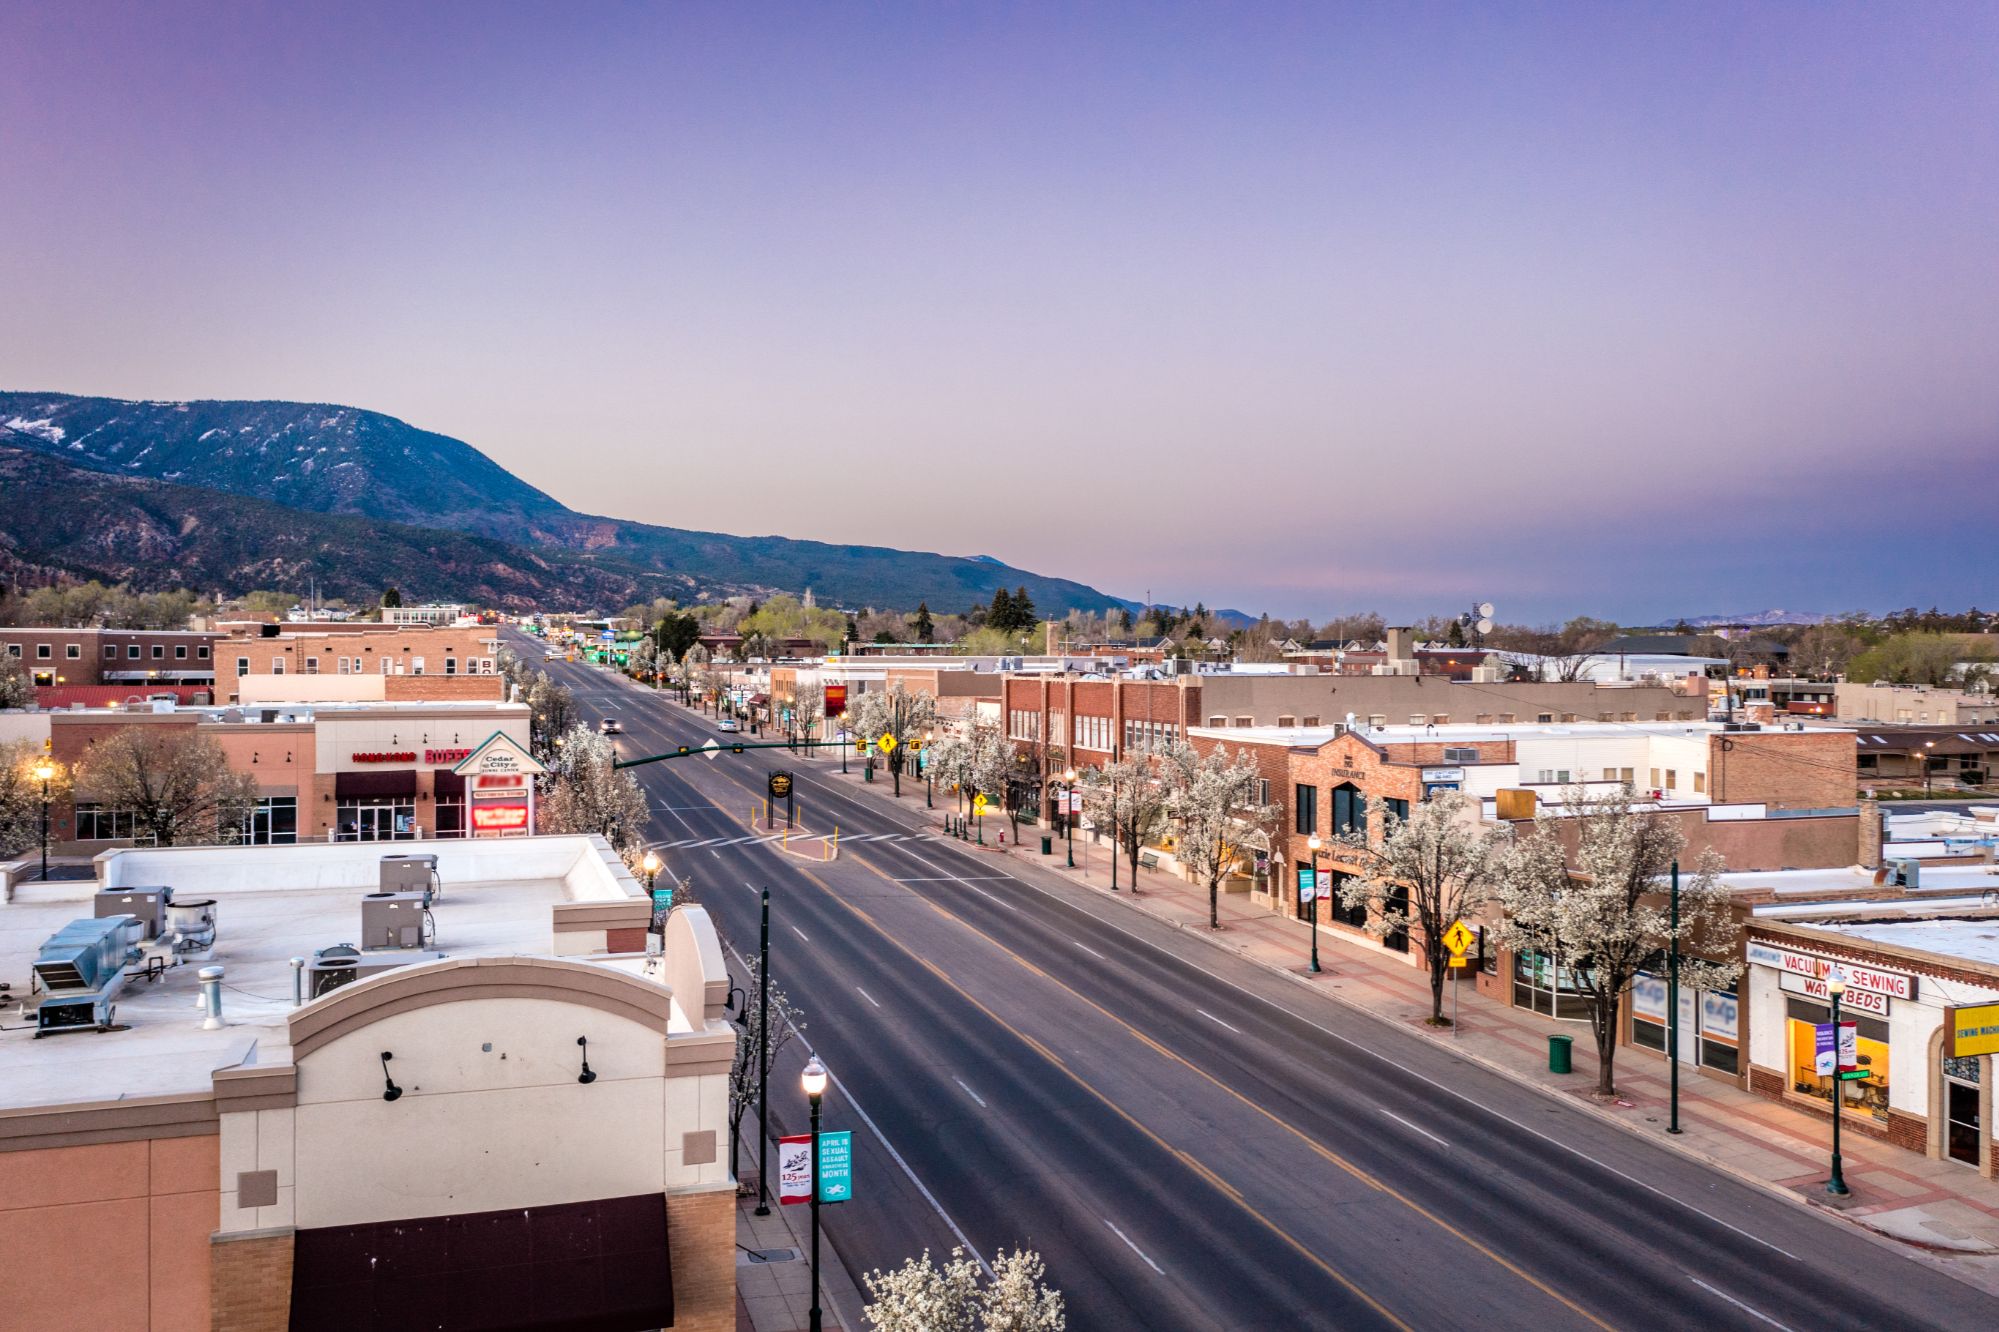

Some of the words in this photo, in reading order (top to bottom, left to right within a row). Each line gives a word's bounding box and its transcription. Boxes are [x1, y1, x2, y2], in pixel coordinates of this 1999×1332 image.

[425, 749, 474, 764] BUFF
[1784, 954, 1831, 976] VACUUM
[1852, 970, 1905, 995] SEWING
[1804, 979, 1882, 1010] WATBEDS
[822, 1139, 840, 1147] APRIL
[822, 1147, 848, 1156] SEXUAL
[822, 1155, 848, 1163] ASSAULT
[782, 1173, 798, 1181] 125
[822, 1169, 848, 1179] MONTH
